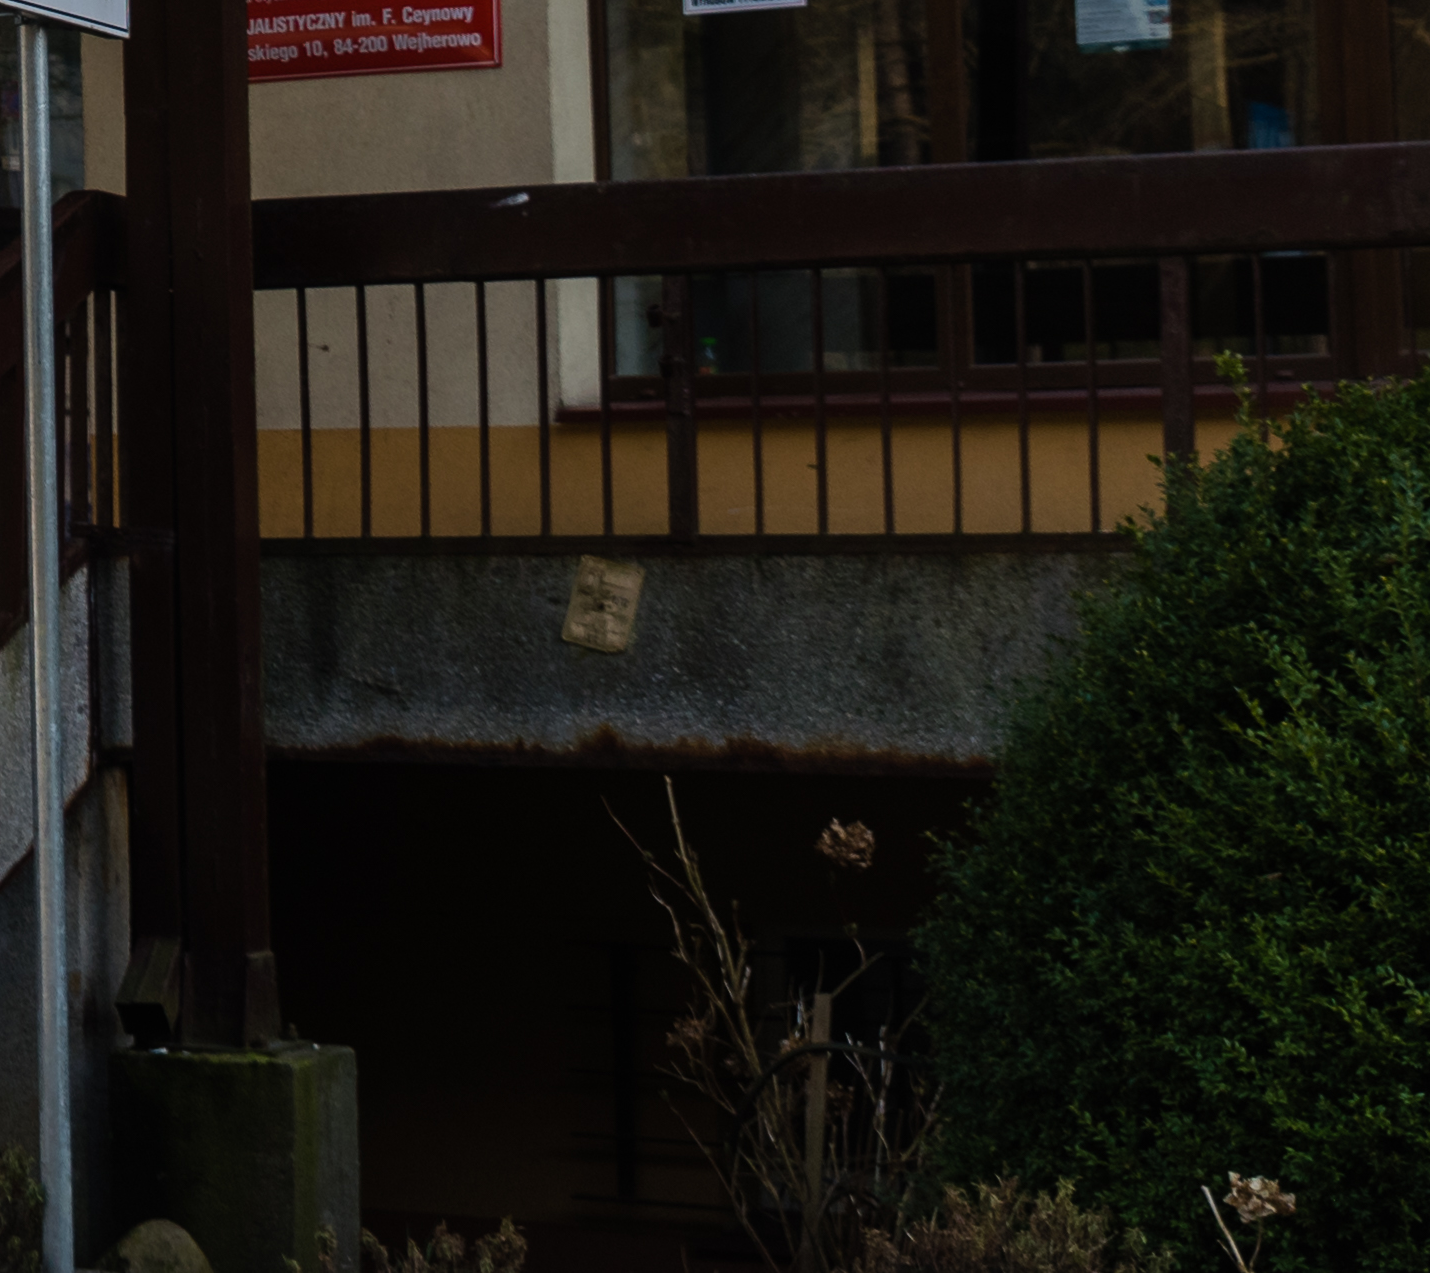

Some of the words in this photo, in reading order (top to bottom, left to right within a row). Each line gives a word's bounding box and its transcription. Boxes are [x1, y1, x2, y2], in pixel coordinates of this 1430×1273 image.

[247, 11, 346, 36] JALISTYCZNY
[351, 10, 376, 27] im.
[381, 7, 396, 25] F.
[401, 5, 474, 26] Ceynowy
[247, 42, 298, 63] skiego
[302, 40, 328, 58] 10,
[333, 36, 387, 55] 84-200
[392, 32, 482, 53] Wejherowo
